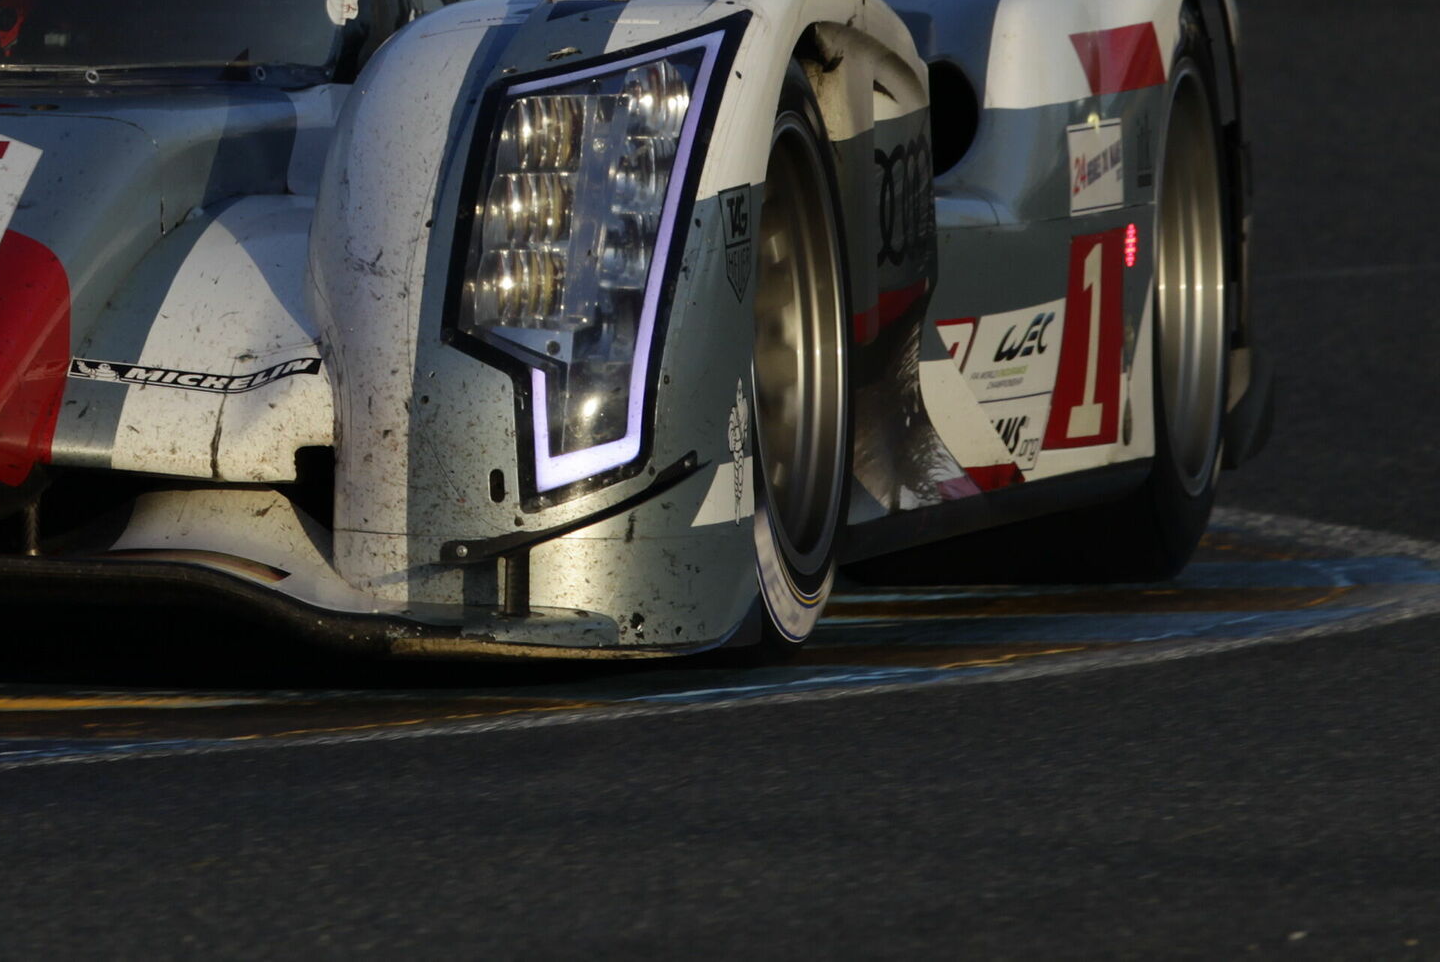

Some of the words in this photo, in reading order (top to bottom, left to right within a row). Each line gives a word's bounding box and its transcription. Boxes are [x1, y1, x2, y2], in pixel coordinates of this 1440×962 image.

[726, 194, 749, 239] TAG
[993, 311, 1056, 363] WEC
[1064, 242, 1105, 439] 1
[121, 357, 316, 390] MICHELIN
